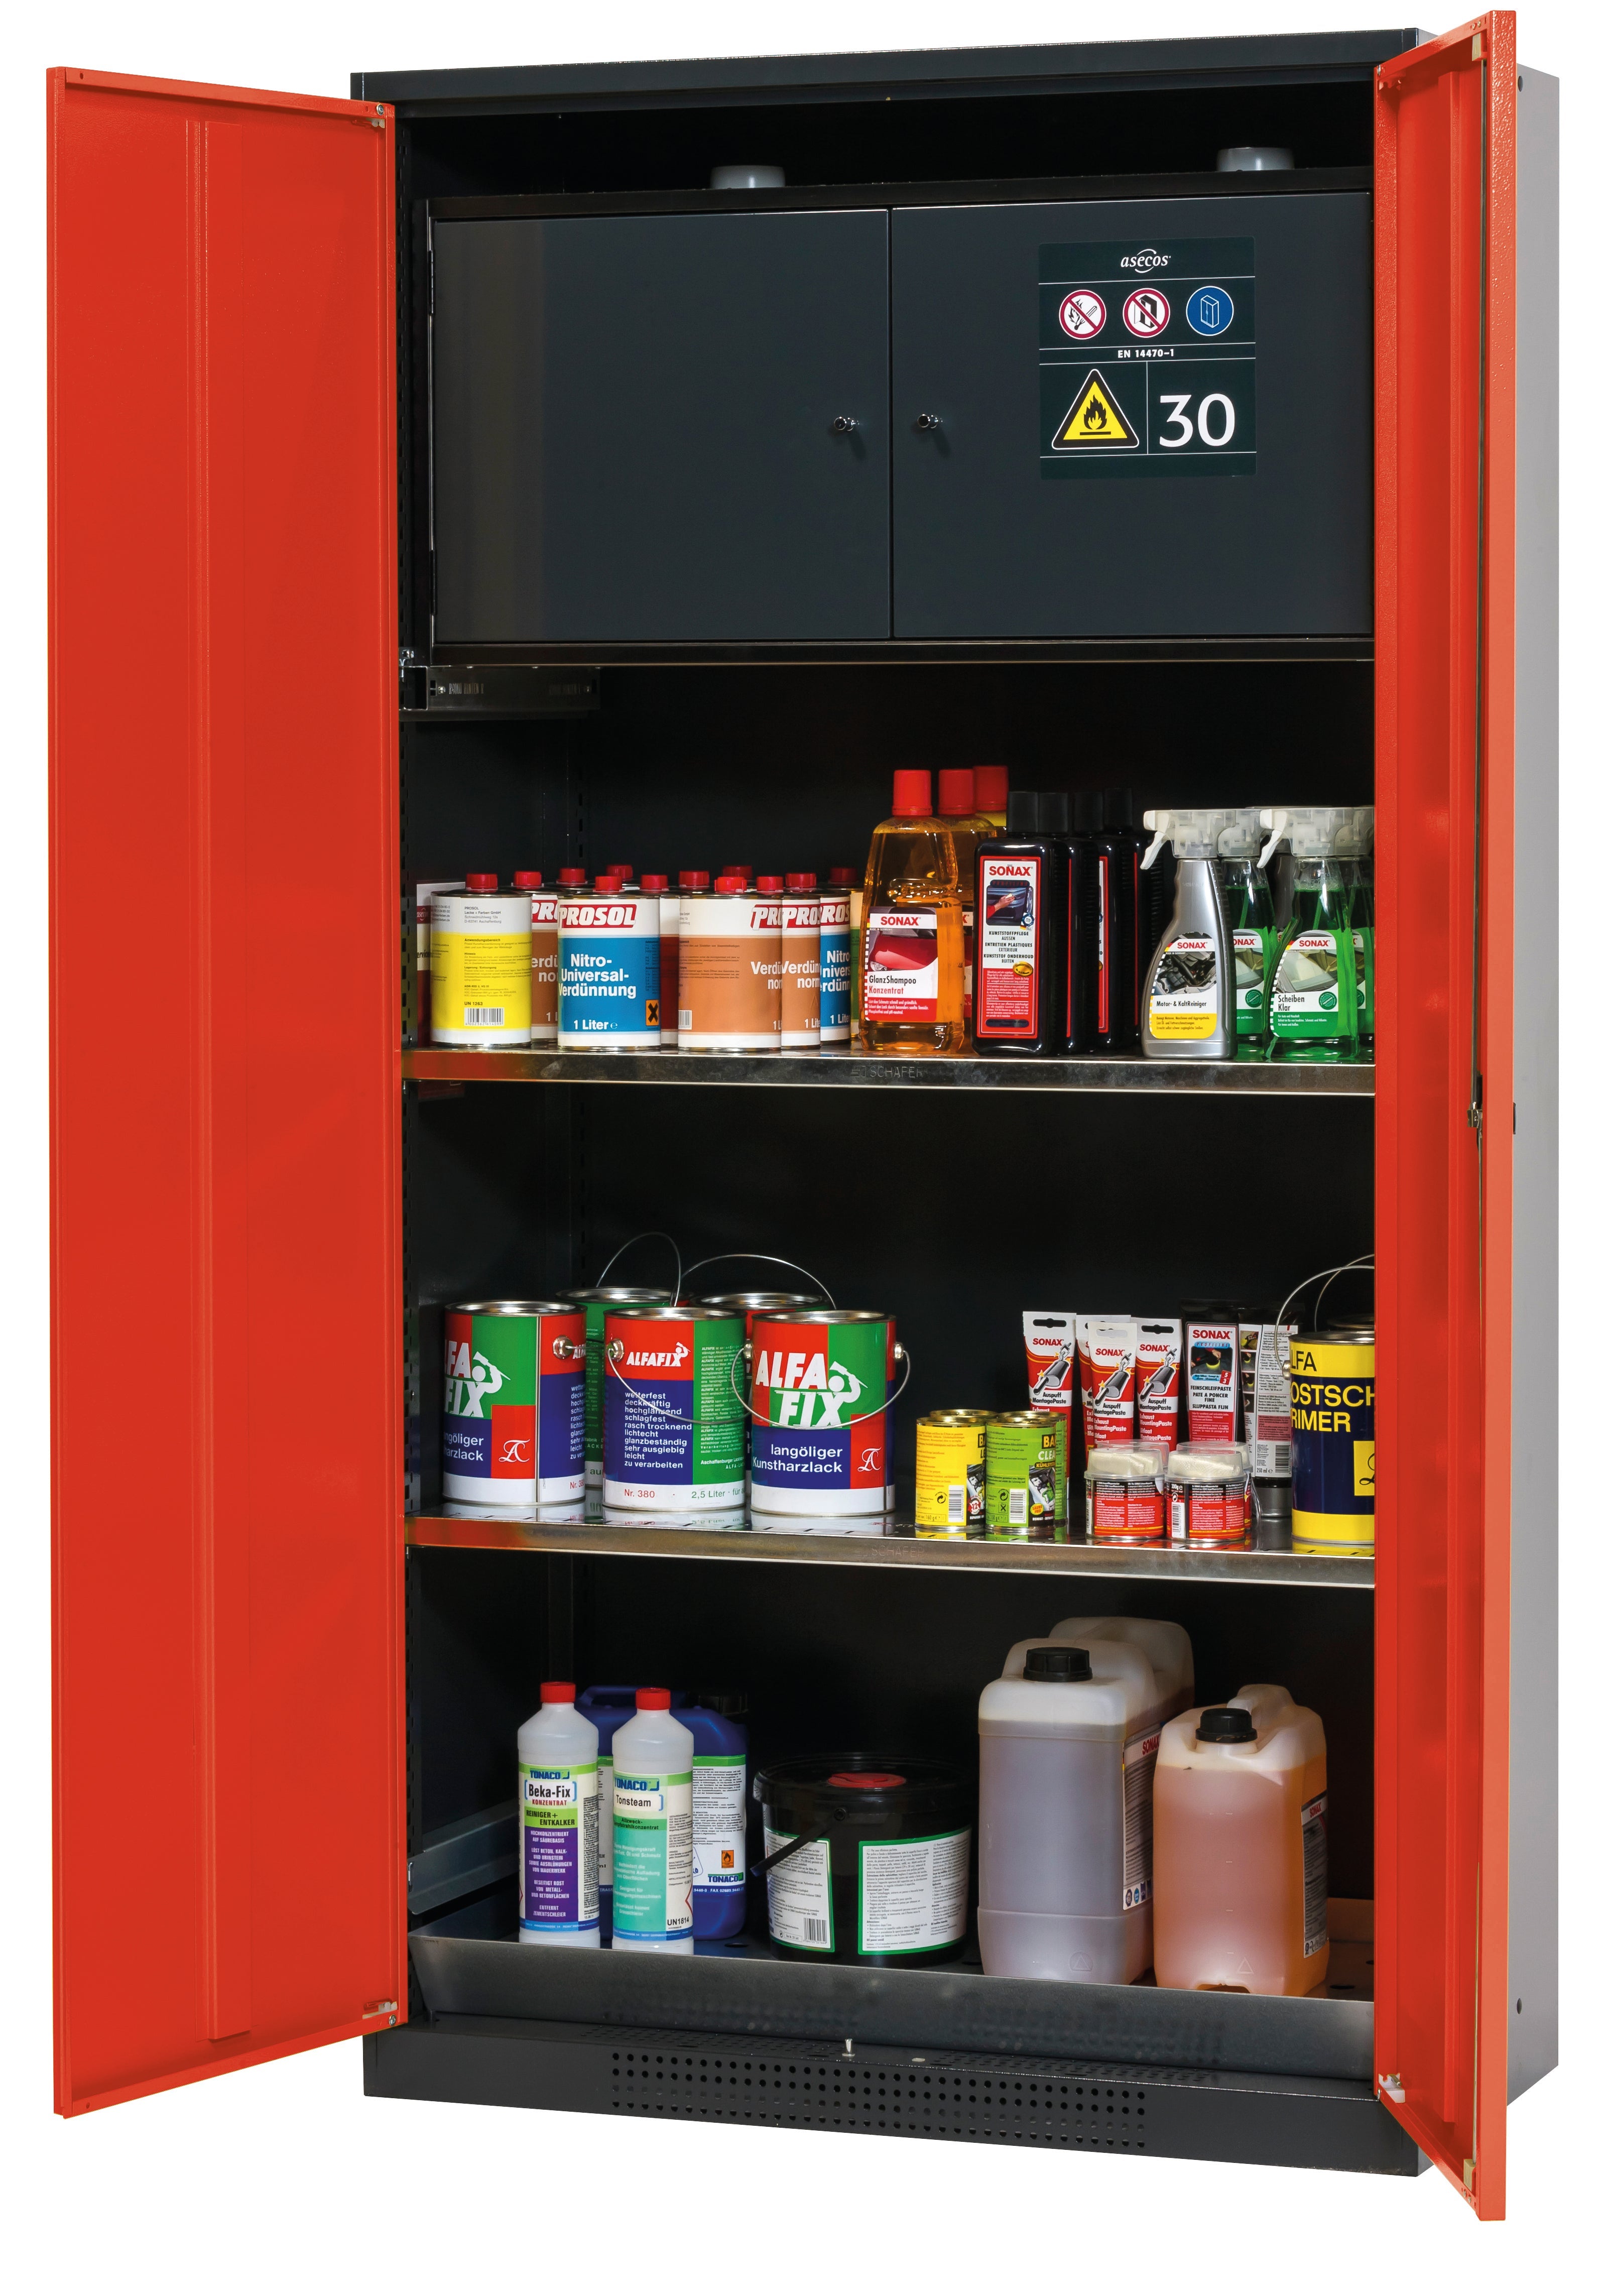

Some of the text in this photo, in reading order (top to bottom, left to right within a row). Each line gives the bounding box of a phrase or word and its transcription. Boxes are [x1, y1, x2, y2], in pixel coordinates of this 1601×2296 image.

[1121, 253, 1169, 269] asecos
[1118, 348, 1174, 358] EN 14470-1
[1160, 393, 1235, 447] 30
[989, 866, 1031, 876] SONAX
[559, 906, 637, 930] PROSOL
[881, 916, 919, 926] SONAX
[571, 953, 612, 967] Nitro-
[561, 969, 629, 982] Universal-
[869, 975, 916, 986] GlanzShampoo
[559, 983, 637, 999] Verdünnung
[869, 986, 904, 995] Konzentrat
[1278, 995, 1305, 1003] Scheiben
[574, 1019, 609, 1030] 1 Liter
[1192, 1330, 1230, 1340] SONAX
[1095, 1348, 1124, 1356] SONAX
[626, 1352, 682, 1367] ALFAFIX
[756, 1351, 828, 1389] ALFA
[774, 1390, 847, 1429] FIX
[1094, 1408, 1126, 1416] MontagePaste
[625, 1414, 666, 1423] schlagfest
[625, 1437, 687, 1446] glanzbeständig
[643, 1446, 685, 1455] ausgiebig
[771, 1443, 843, 1459] langöliger
[753, 1456, 843, 1473] Kunstharzlack
[625, 1489, 635, 1497] Nr.
[638, 1490, 655, 1498] 380
[691, 1491, 705, 1500] 2,5
[530, 1770, 561, 1779] TONACO
[614, 1777, 647, 1791] TONACO
[529, 1783, 571, 1798] Beka-Fix
[616, 1794, 651, 1807] Tonsteam
[526, 1809, 551, 1818] REINIGER
[667, 1916, 689, 1926] UN1814
